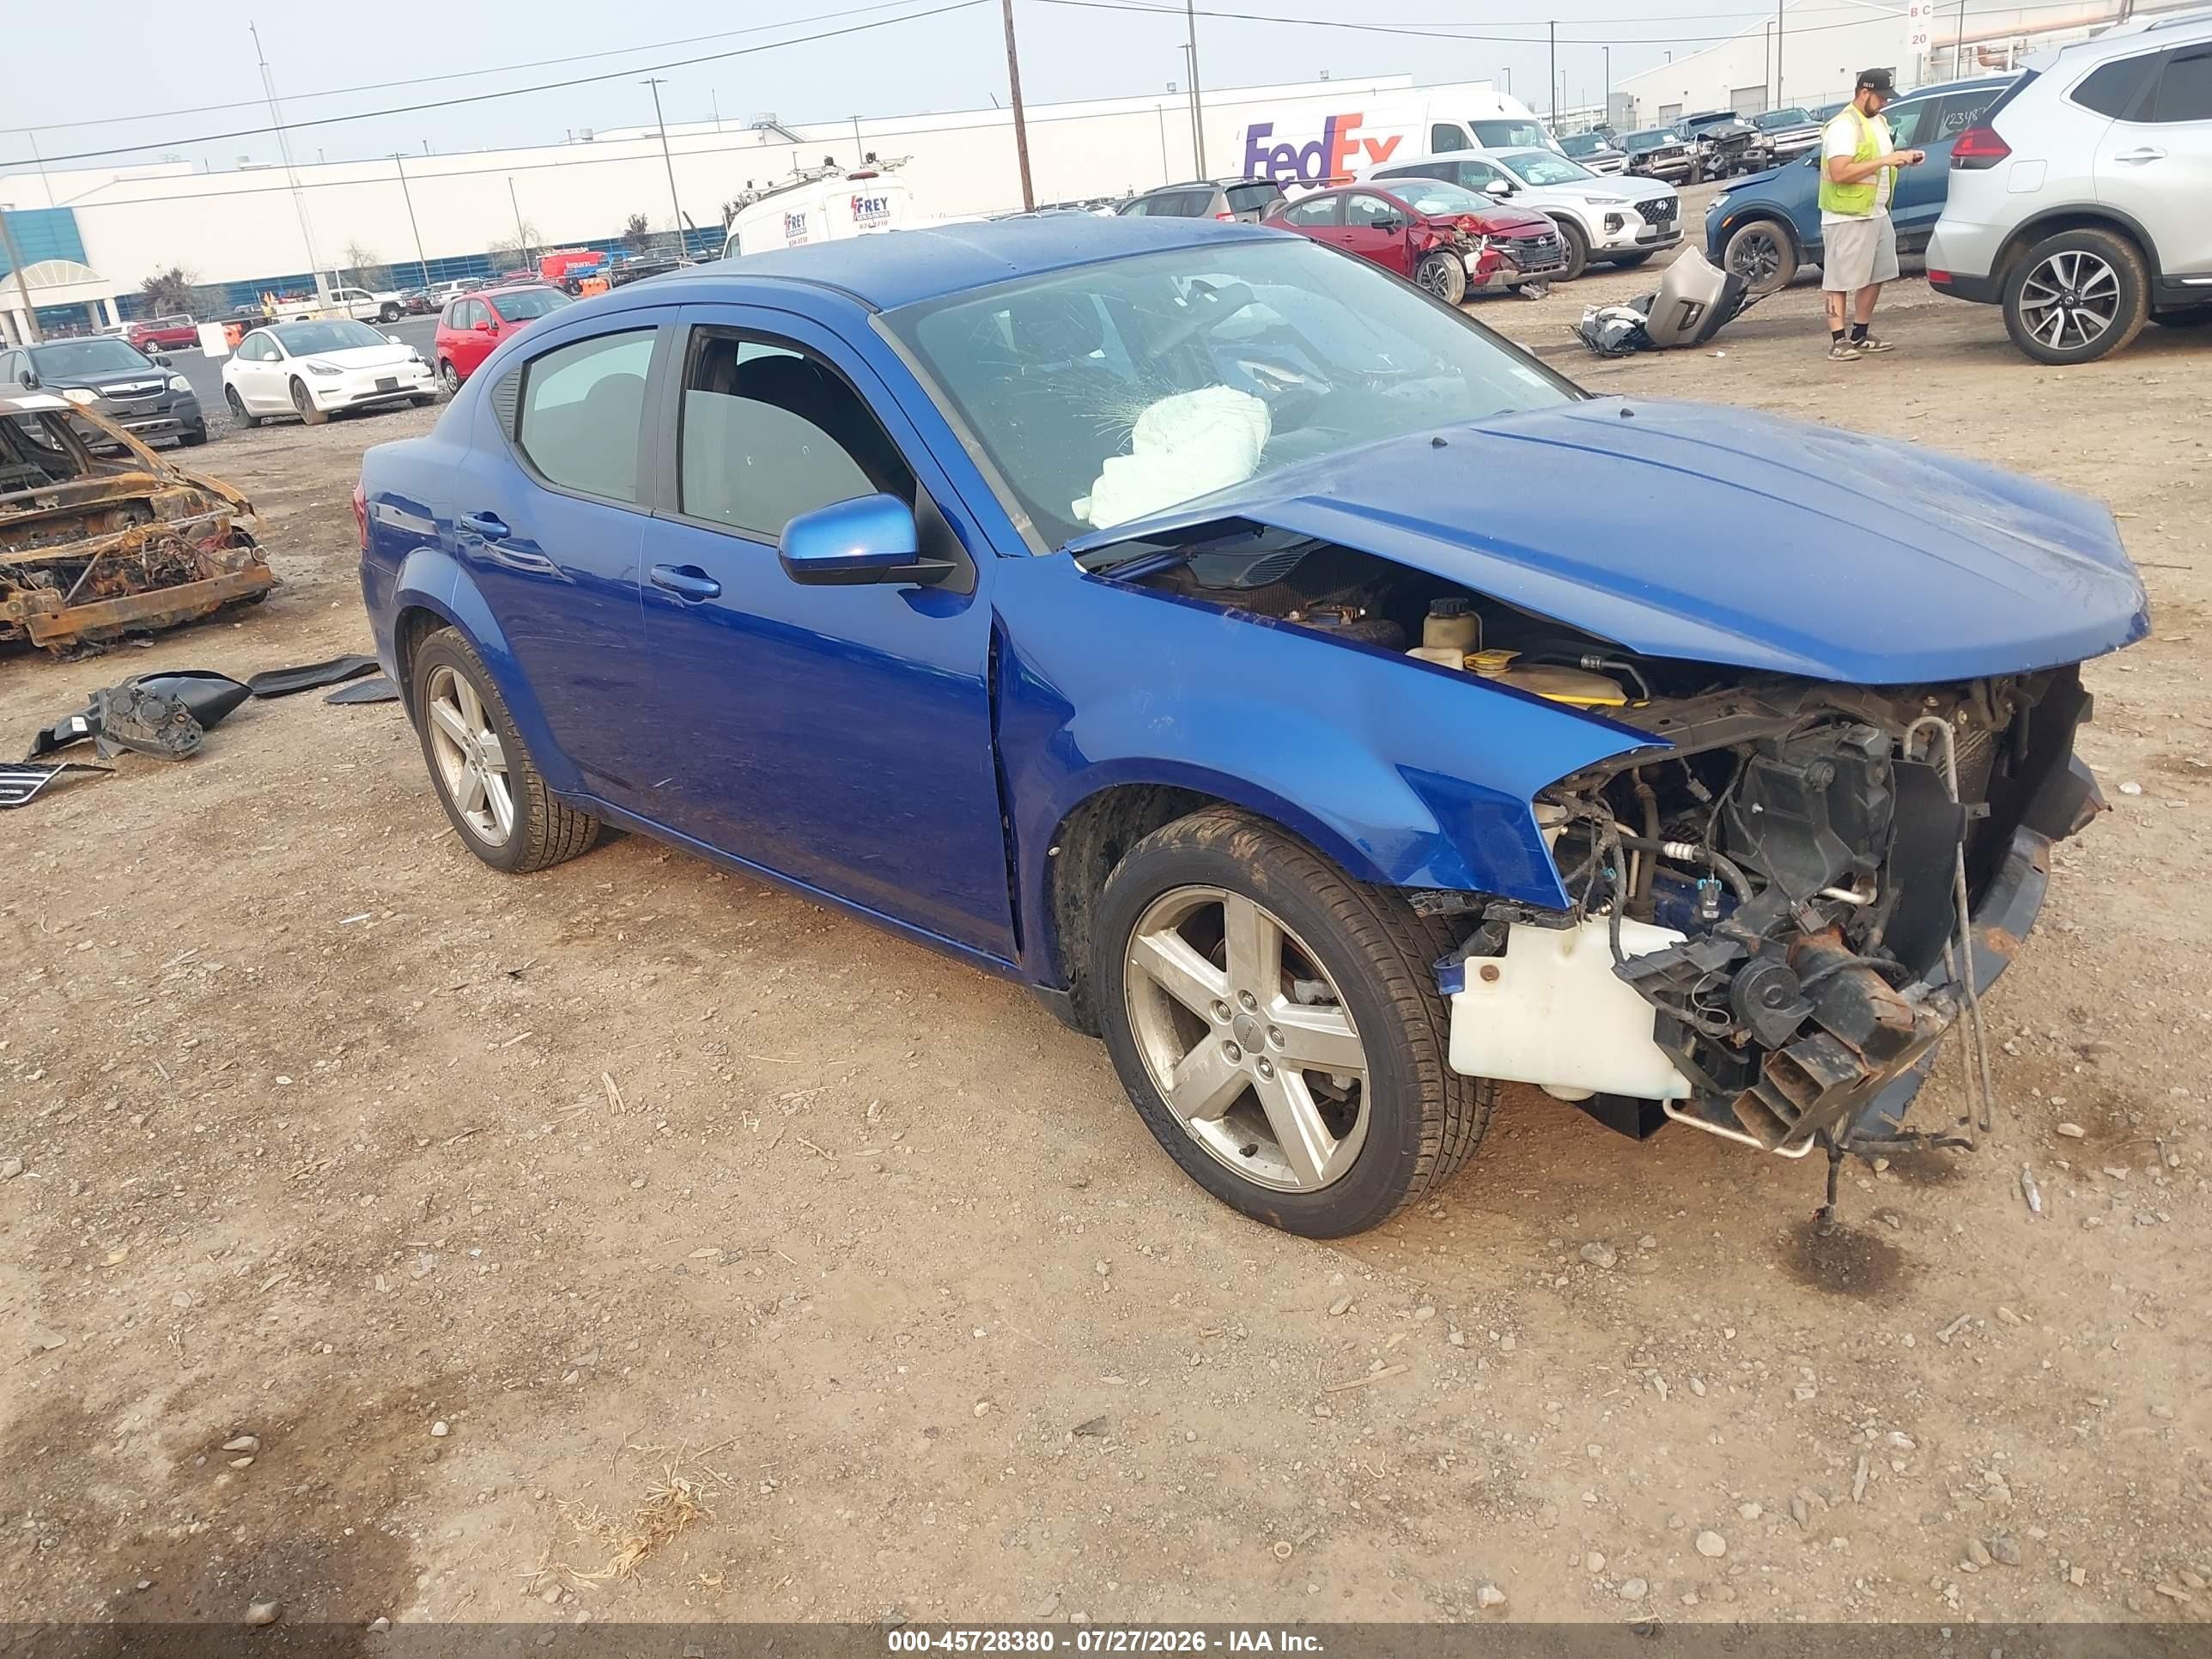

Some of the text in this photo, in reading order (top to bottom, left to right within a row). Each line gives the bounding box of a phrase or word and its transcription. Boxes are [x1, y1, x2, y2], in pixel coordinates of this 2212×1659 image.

[1911, 5, 1931, 17] B C
[1911, 33, 1927, 45] 20
[1243, 112, 1404, 190] FedEx
[855, 197, 888, 214] FREY
[787, 212, 805, 231] FREY
